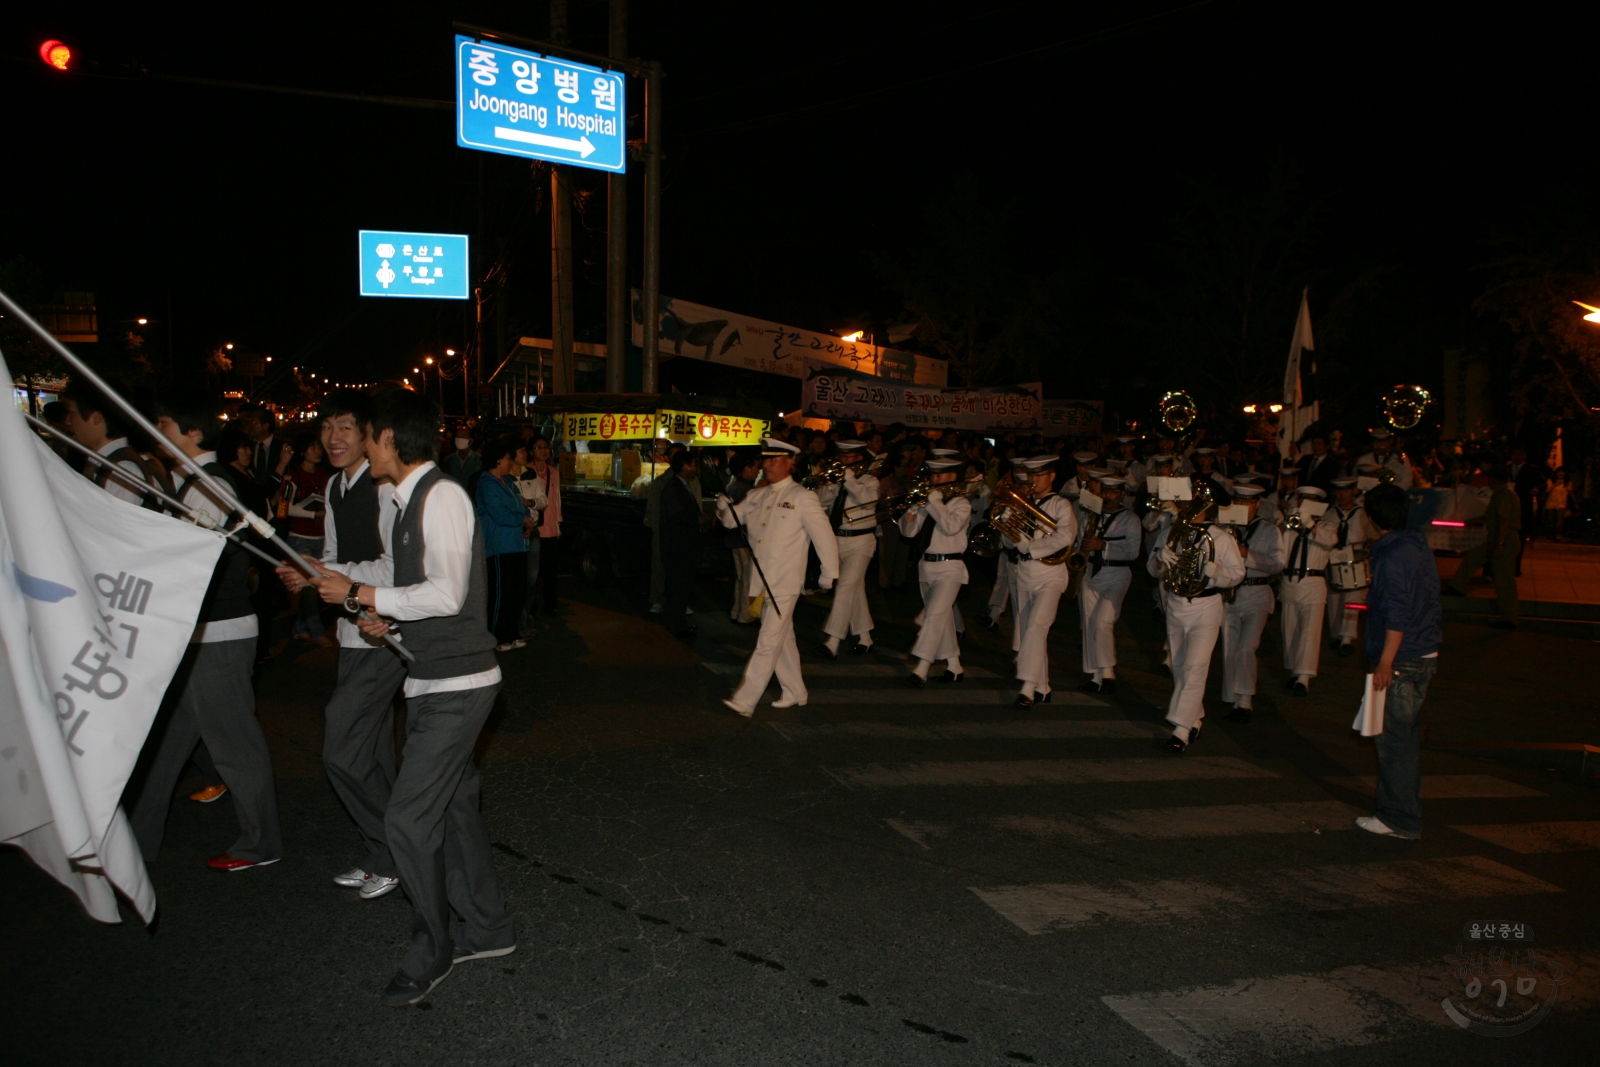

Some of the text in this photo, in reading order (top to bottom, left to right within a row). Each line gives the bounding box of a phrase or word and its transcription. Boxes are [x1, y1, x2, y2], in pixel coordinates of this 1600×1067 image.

[468, 48, 616, 112] 중앙병원
[469, 88, 617, 136] Joongang Hospital
[815, 376, 849, 403] 울산
[853, 386, 897, 408] 고래!!
[950, 394, 980, 414] 함께
[982, 393, 1034, 417] 비상한다
[568, 416, 598, 437] 강원도
[618, 414, 652, 436] 옥수수
[660, 413, 697, 436] 강원도
[719, 416, 753, 439] 옥수수
